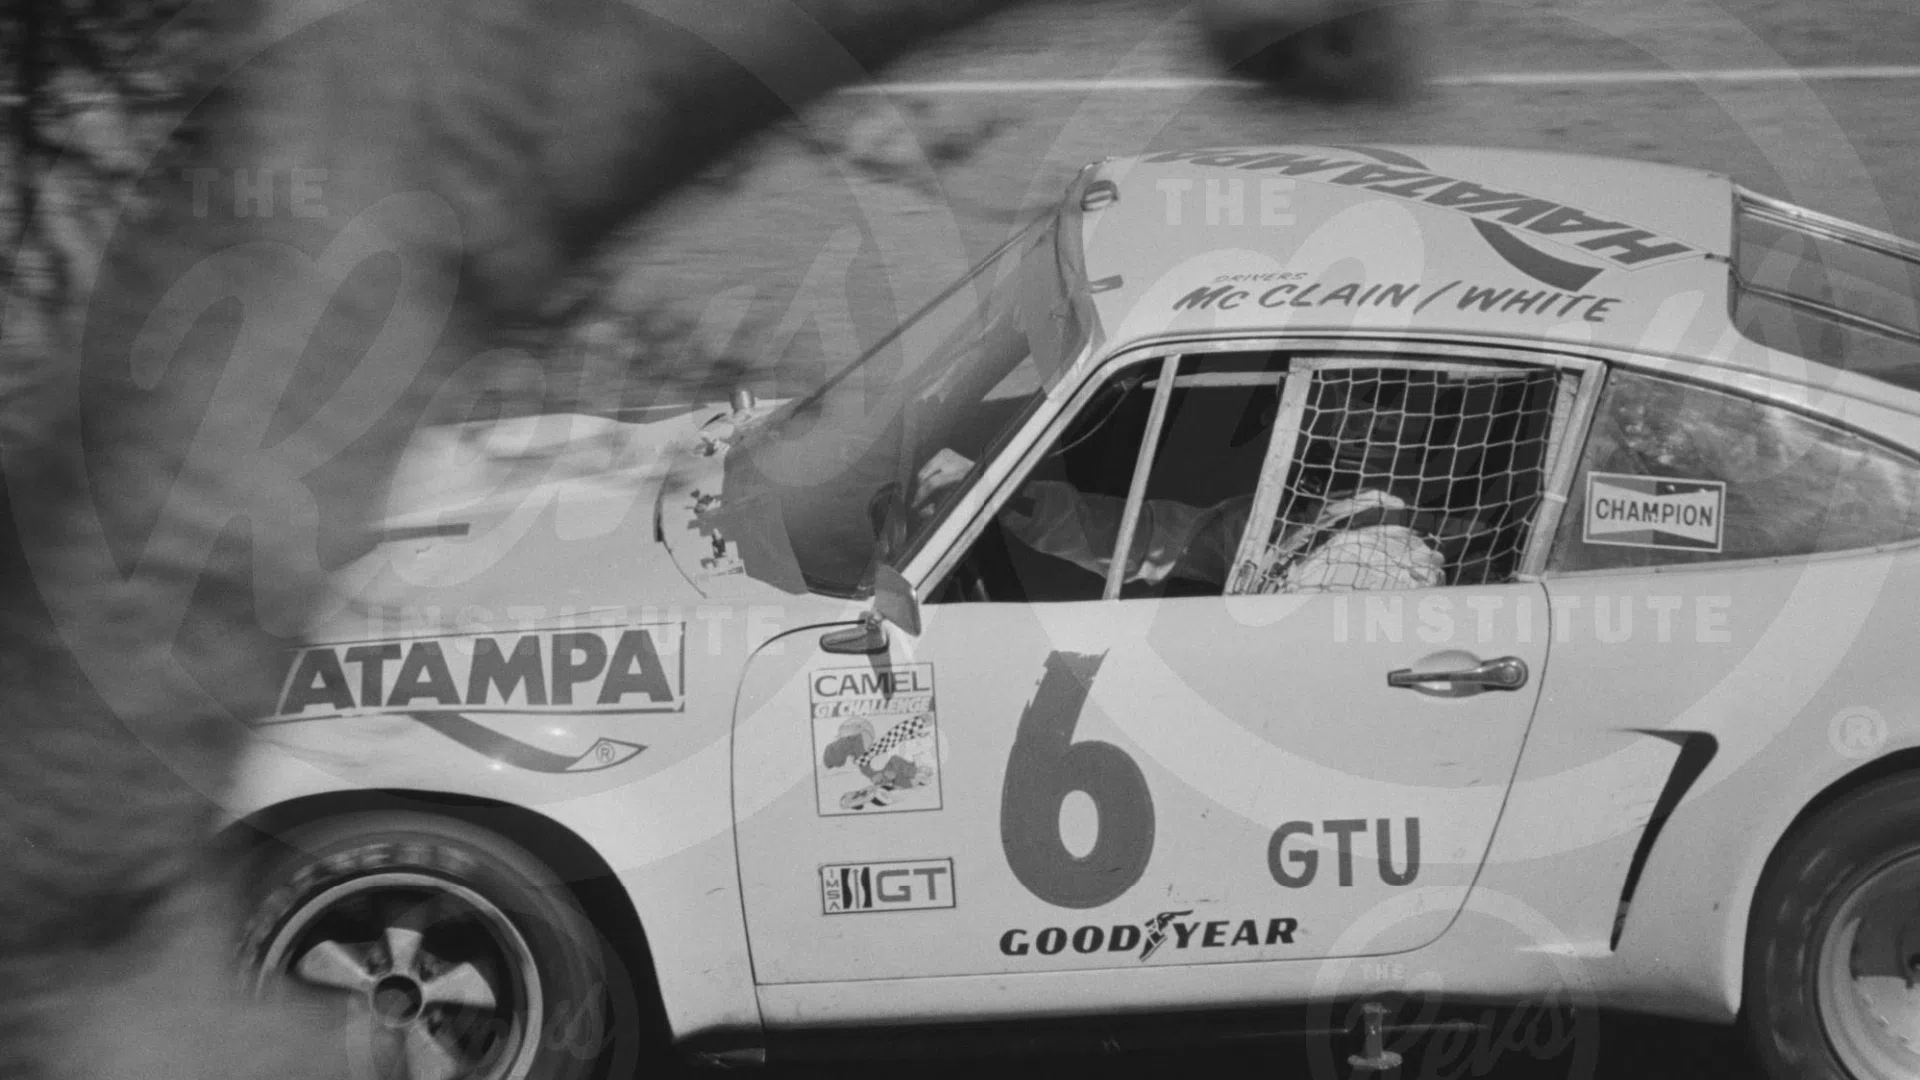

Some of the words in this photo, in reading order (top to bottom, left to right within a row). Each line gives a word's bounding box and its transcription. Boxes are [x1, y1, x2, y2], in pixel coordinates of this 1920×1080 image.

[1143, 149, 1693, 265] HAVATAMPA
[1596, 498, 1713, 527] CHAMPION
[814, 671, 931, 697] CAMEL
[814, 701, 841, 718] GT
[839, 697, 931, 717] CHALLENGE
[1000, 648, 1155, 910] 6
[1267, 817, 1421, 887] GTU
[876, 867, 947, 902] GT
